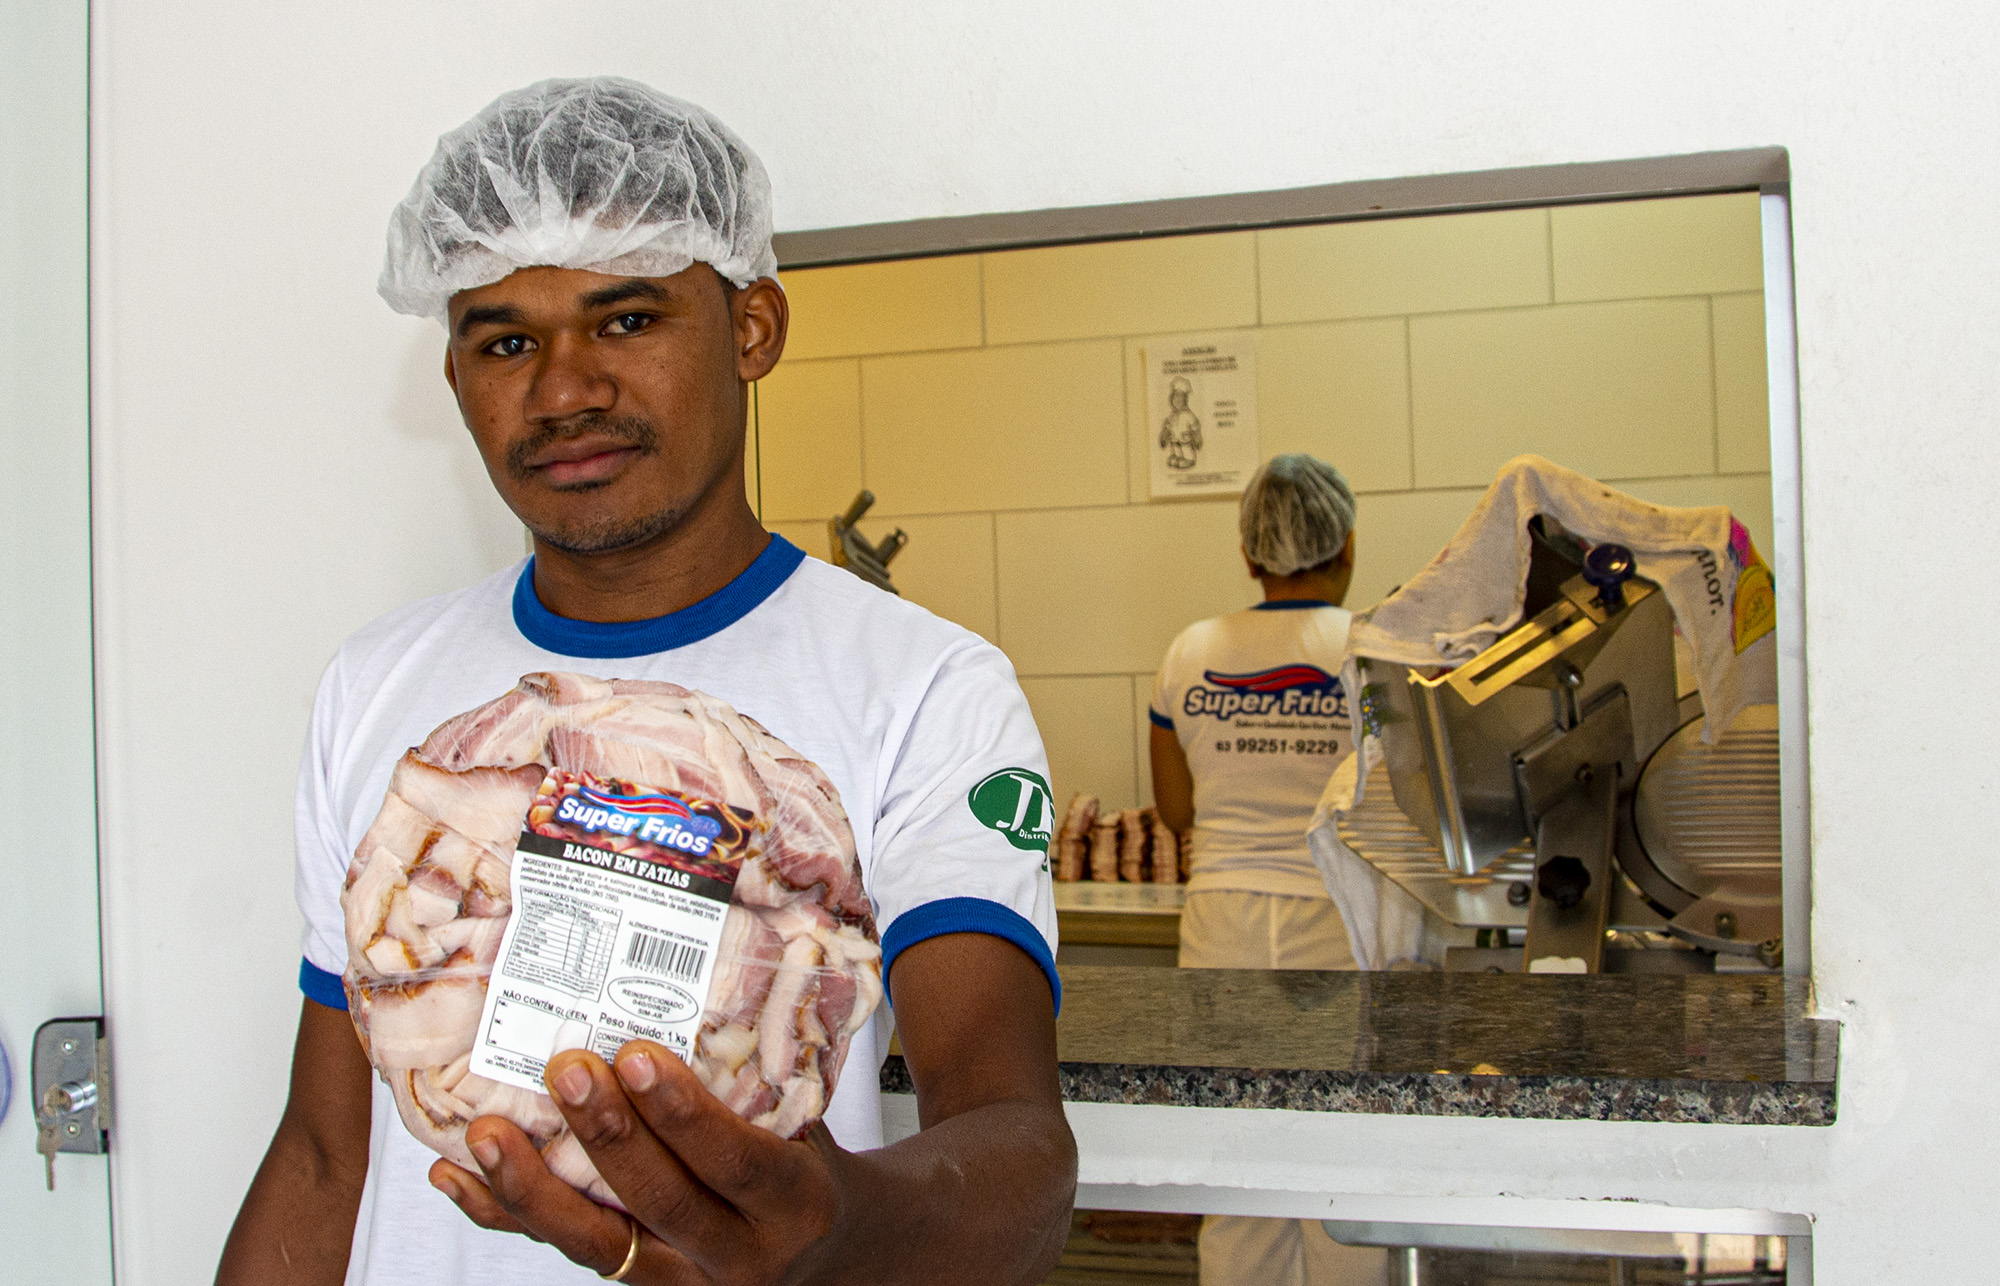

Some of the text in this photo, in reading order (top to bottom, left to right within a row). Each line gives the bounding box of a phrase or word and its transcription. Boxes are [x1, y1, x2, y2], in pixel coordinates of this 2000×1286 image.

[1186, 686, 1350, 720] Super Frios
[1235, 738, 1339, 755] 99251-9229
[558, 797, 639, 834] Super
[640, 816, 711, 854] Frios
[563, 844, 691, 889] BACON EM FATIAS
[522, 887, 570, 903] INFORMAÇÃO
[570, 897, 620, 917] NUTRICIONAL
[503, 989, 522, 1001] NÃO
[523, 995, 554, 1012] CONTÉM
[621, 988, 684, 1010] REINSPECIONADO
[599, 1012, 625, 1029] Peso
[626, 1020, 664, 1041] líquido:
[675, 1032, 688, 1047] kg
